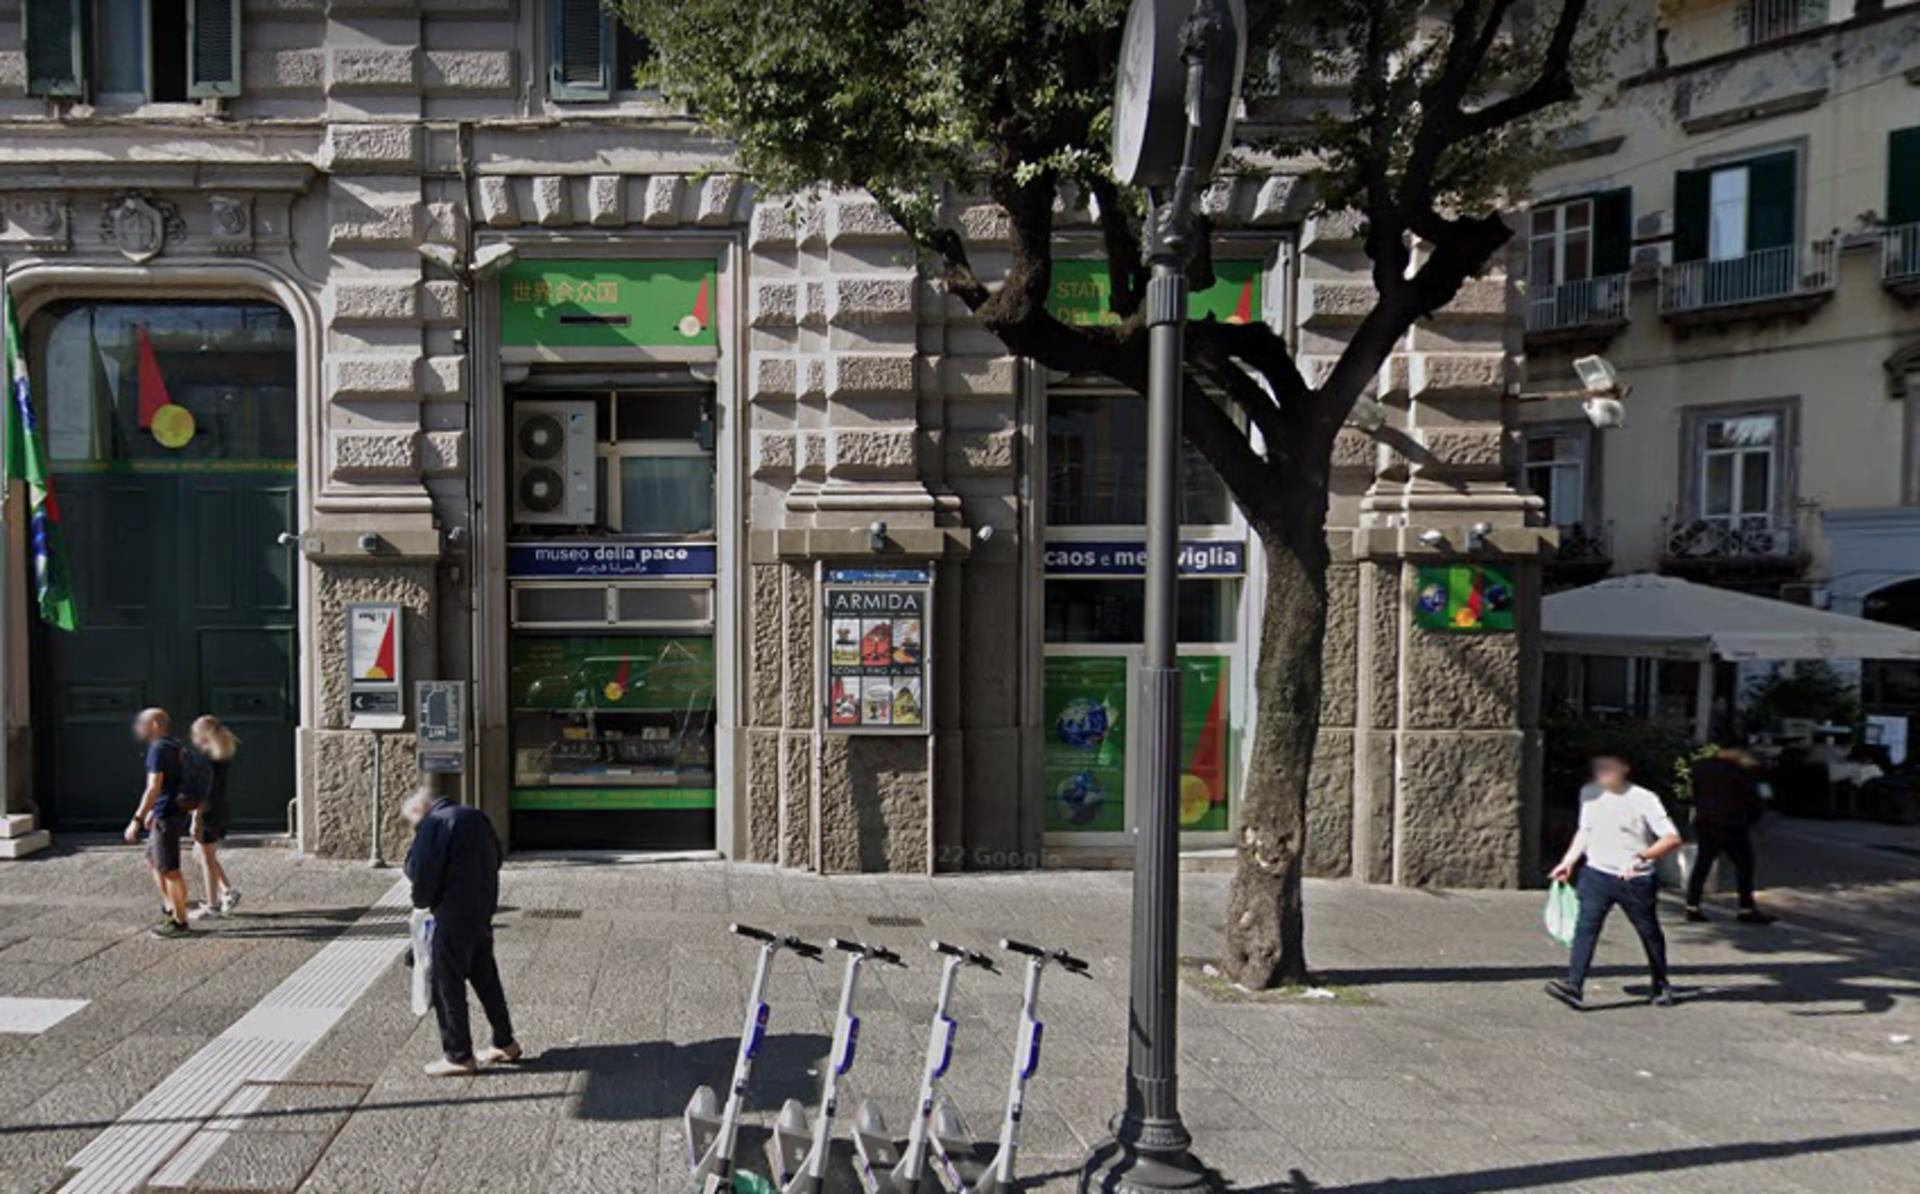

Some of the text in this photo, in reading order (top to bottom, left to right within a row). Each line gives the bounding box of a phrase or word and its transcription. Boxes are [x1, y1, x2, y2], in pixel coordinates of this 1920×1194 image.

[1057, 306, 1096, 326] DEL
[535, 546, 687, 562] museo della pace
[1044, 550, 1095, 566] caos
[1100, 556, 1110, 566] e
[834, 593, 917, 609] ARMIDA
